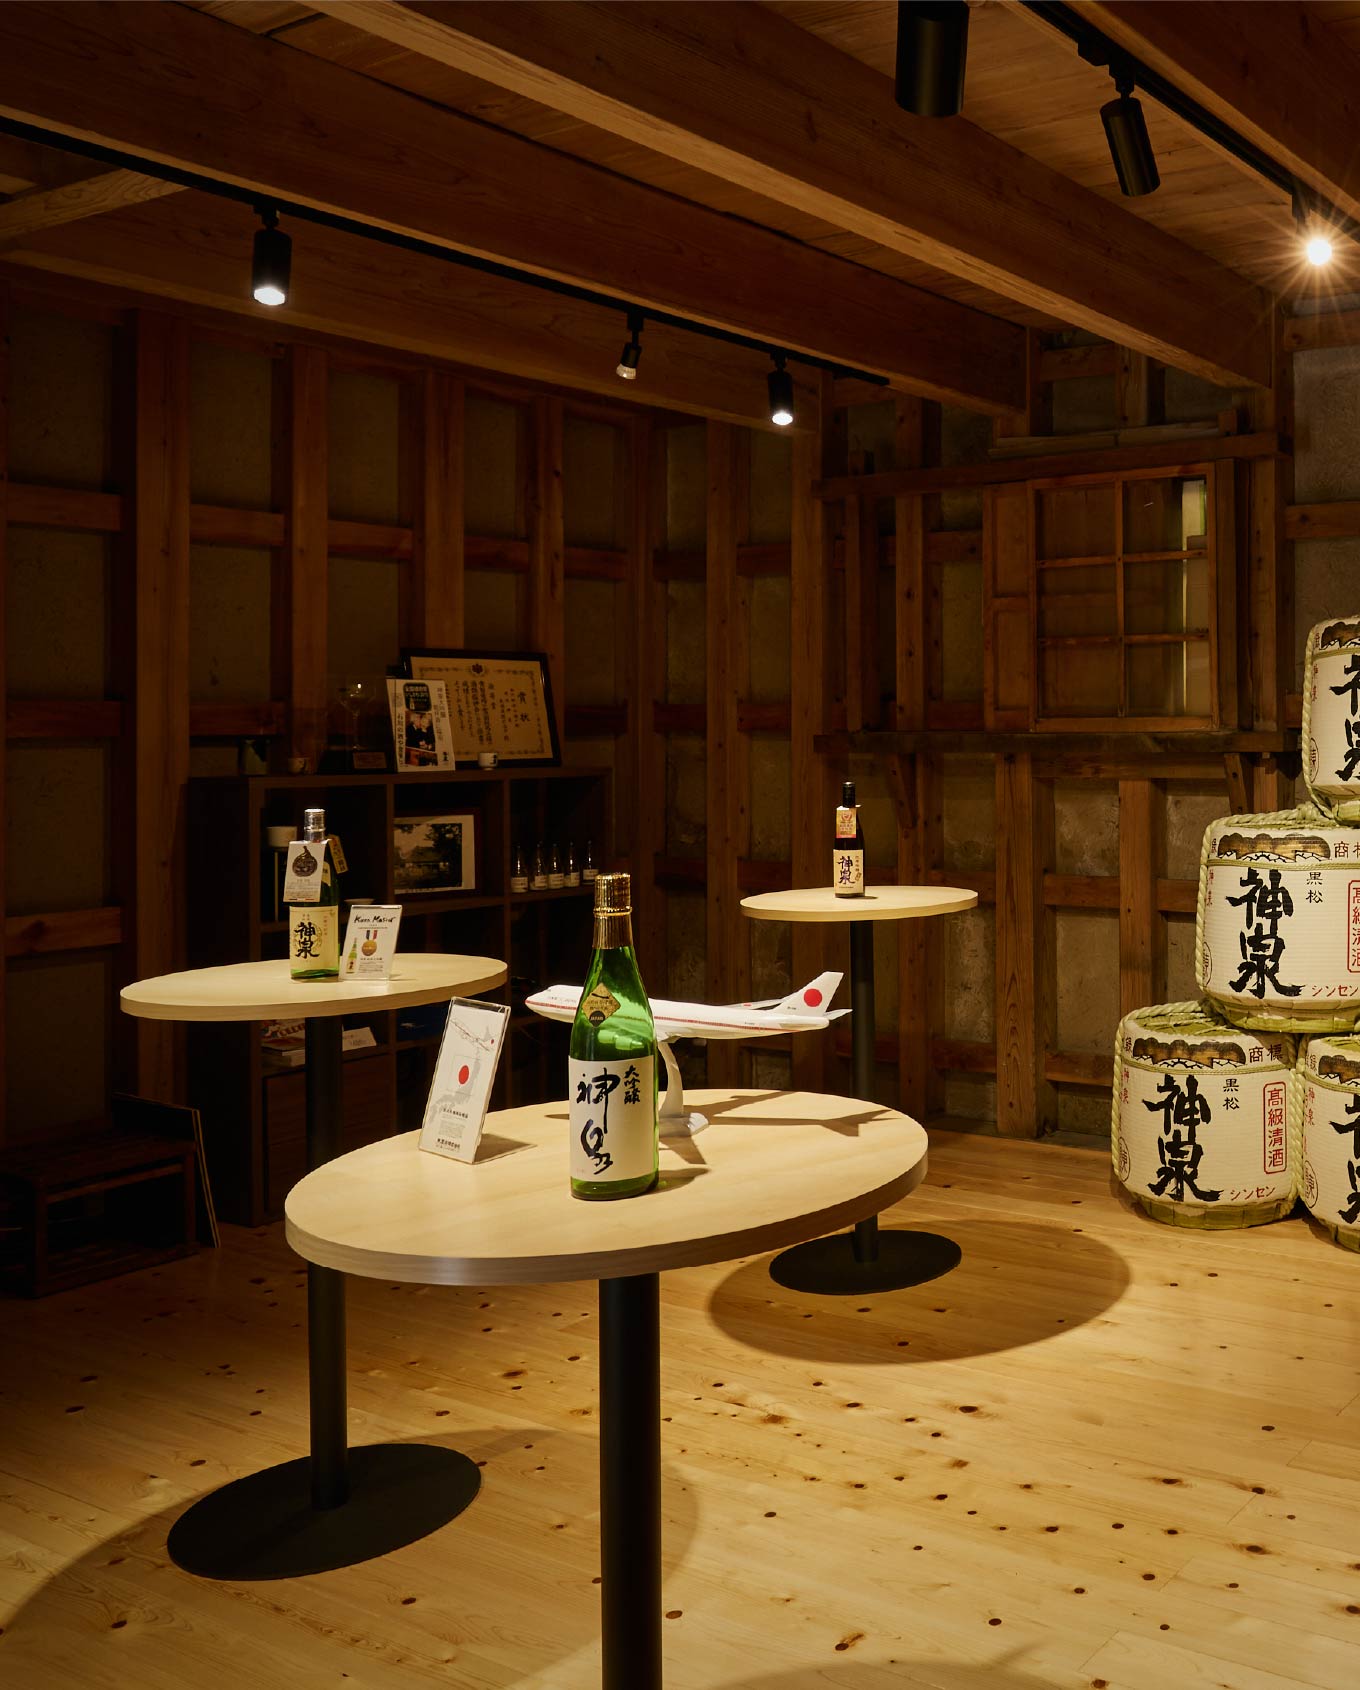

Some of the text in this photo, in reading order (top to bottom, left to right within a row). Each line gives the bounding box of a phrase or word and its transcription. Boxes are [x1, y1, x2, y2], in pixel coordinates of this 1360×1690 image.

[836, 855, 856, 885] 神泉
[1306, 871, 1323, 904] 黒松
[293, 922, 320, 959] 神泉
[1225, 867, 1305, 999] 神泉
[1311, 984, 1360, 998] シンセン
[1248, 1043, 1284, 1063] 商標
[623, 1065, 641, 1105] 大吟醸
[1222, 1078, 1240, 1111] 黒松
[576, 1067, 621, 1175] 神泉
[1142, 1074, 1225, 1202] 神泉
[1230, 1185, 1276, 1200] シンセン
